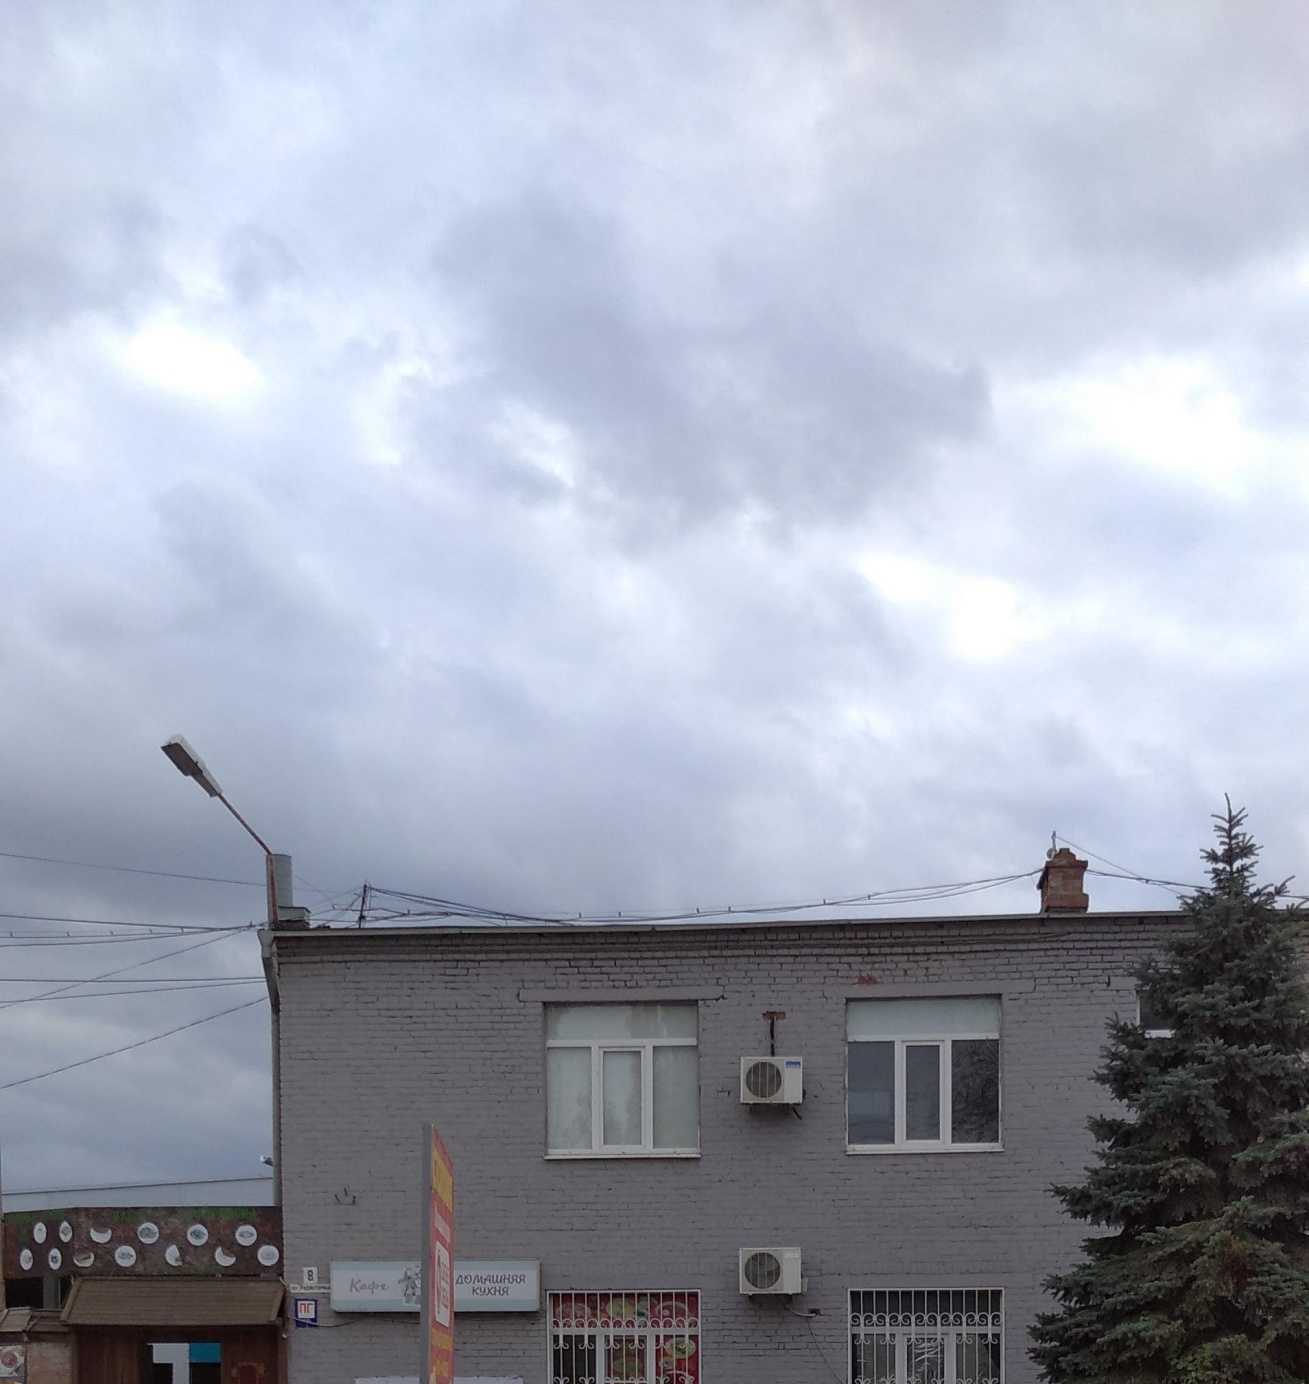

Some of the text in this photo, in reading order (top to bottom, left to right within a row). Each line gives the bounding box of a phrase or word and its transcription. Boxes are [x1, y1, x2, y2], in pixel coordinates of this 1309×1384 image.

[307, 1270, 314, 1281] 8
[455, 1273, 527, 1285] ДОМАШНЯЯ
[349, 1277, 389, 1295] Кафе
[472, 1286, 510, 1297] КУХНЯ
